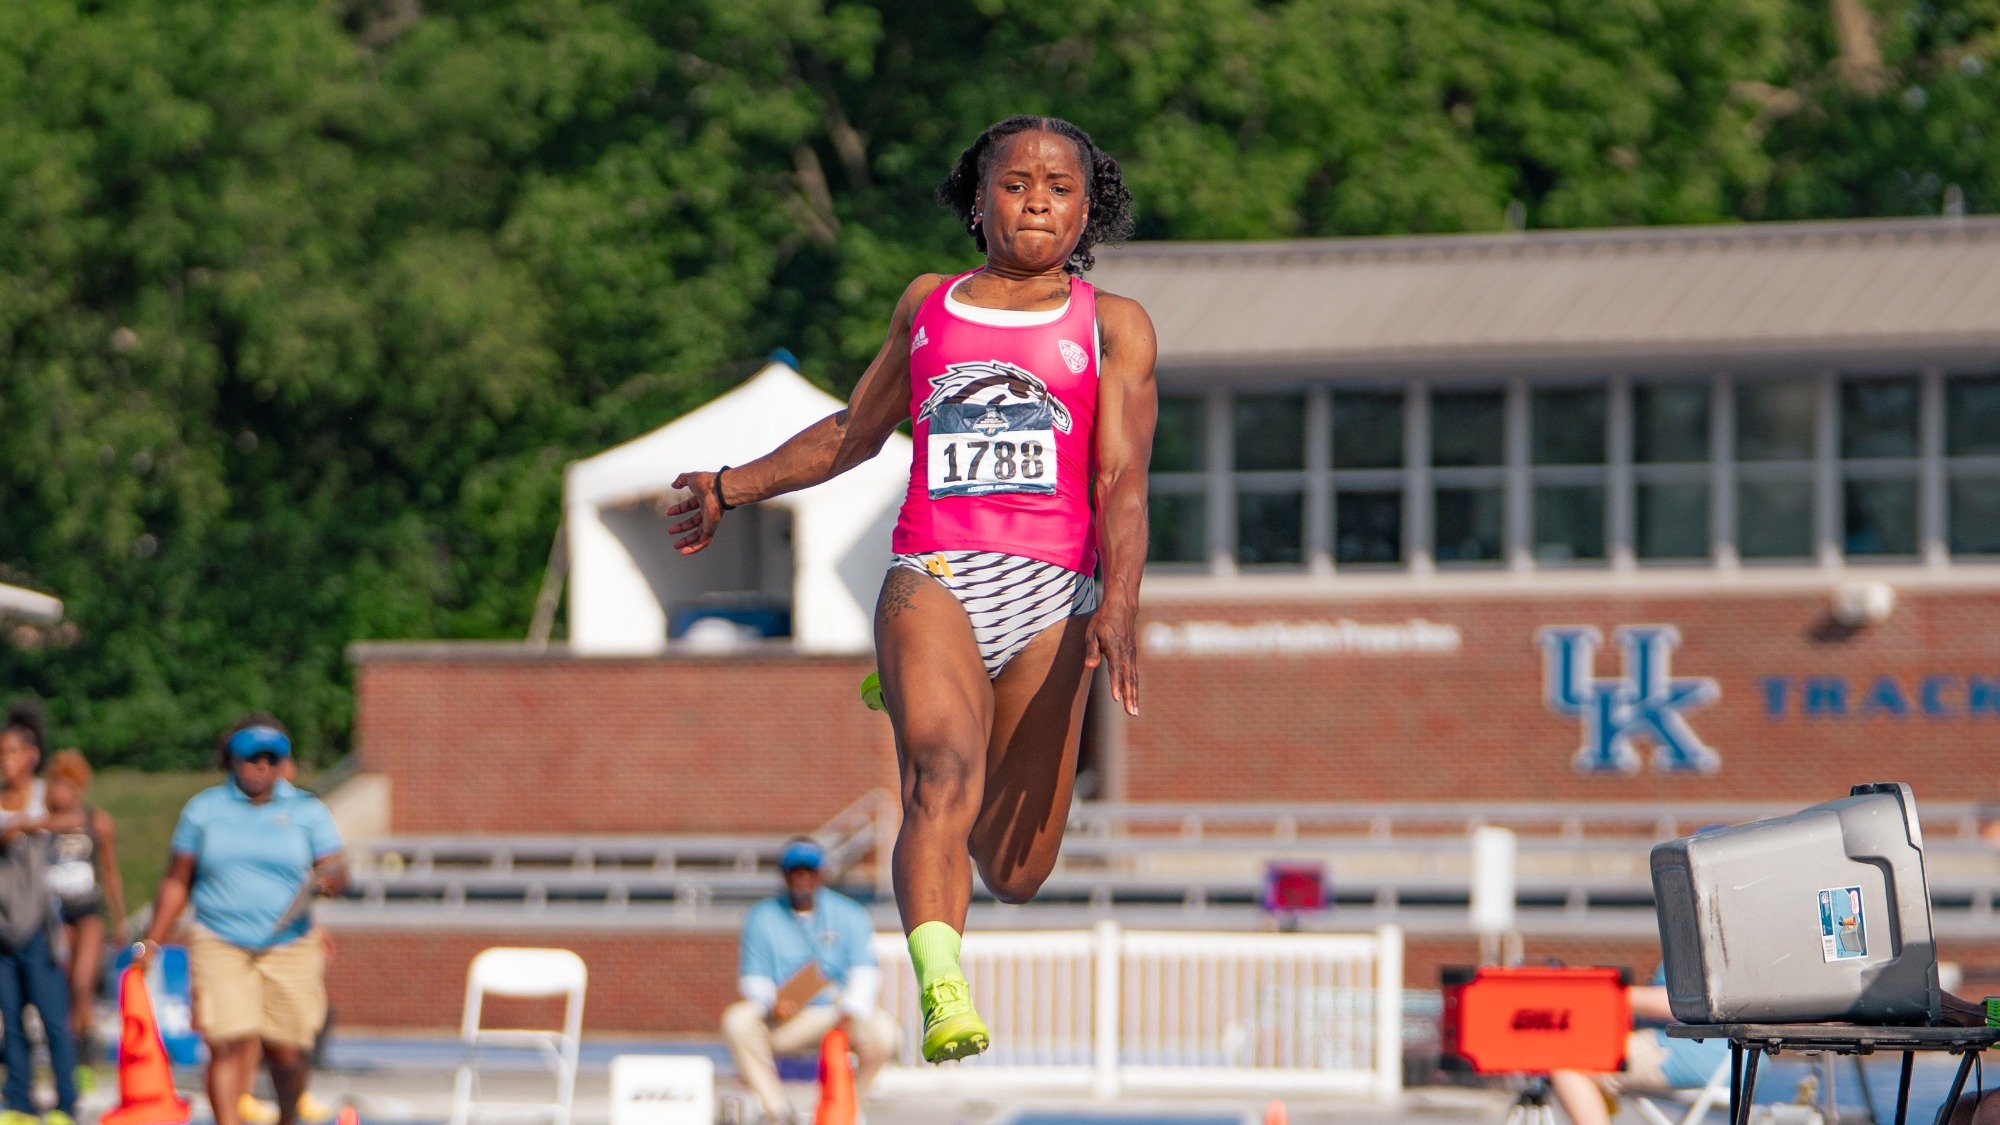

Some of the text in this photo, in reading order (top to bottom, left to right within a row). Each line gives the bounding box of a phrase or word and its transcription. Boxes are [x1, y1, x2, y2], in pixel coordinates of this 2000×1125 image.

[943, 440, 1044, 483] 1788
[1534, 624, 1722, 774] UK
[1758, 674, 2000, 719] TRACK
